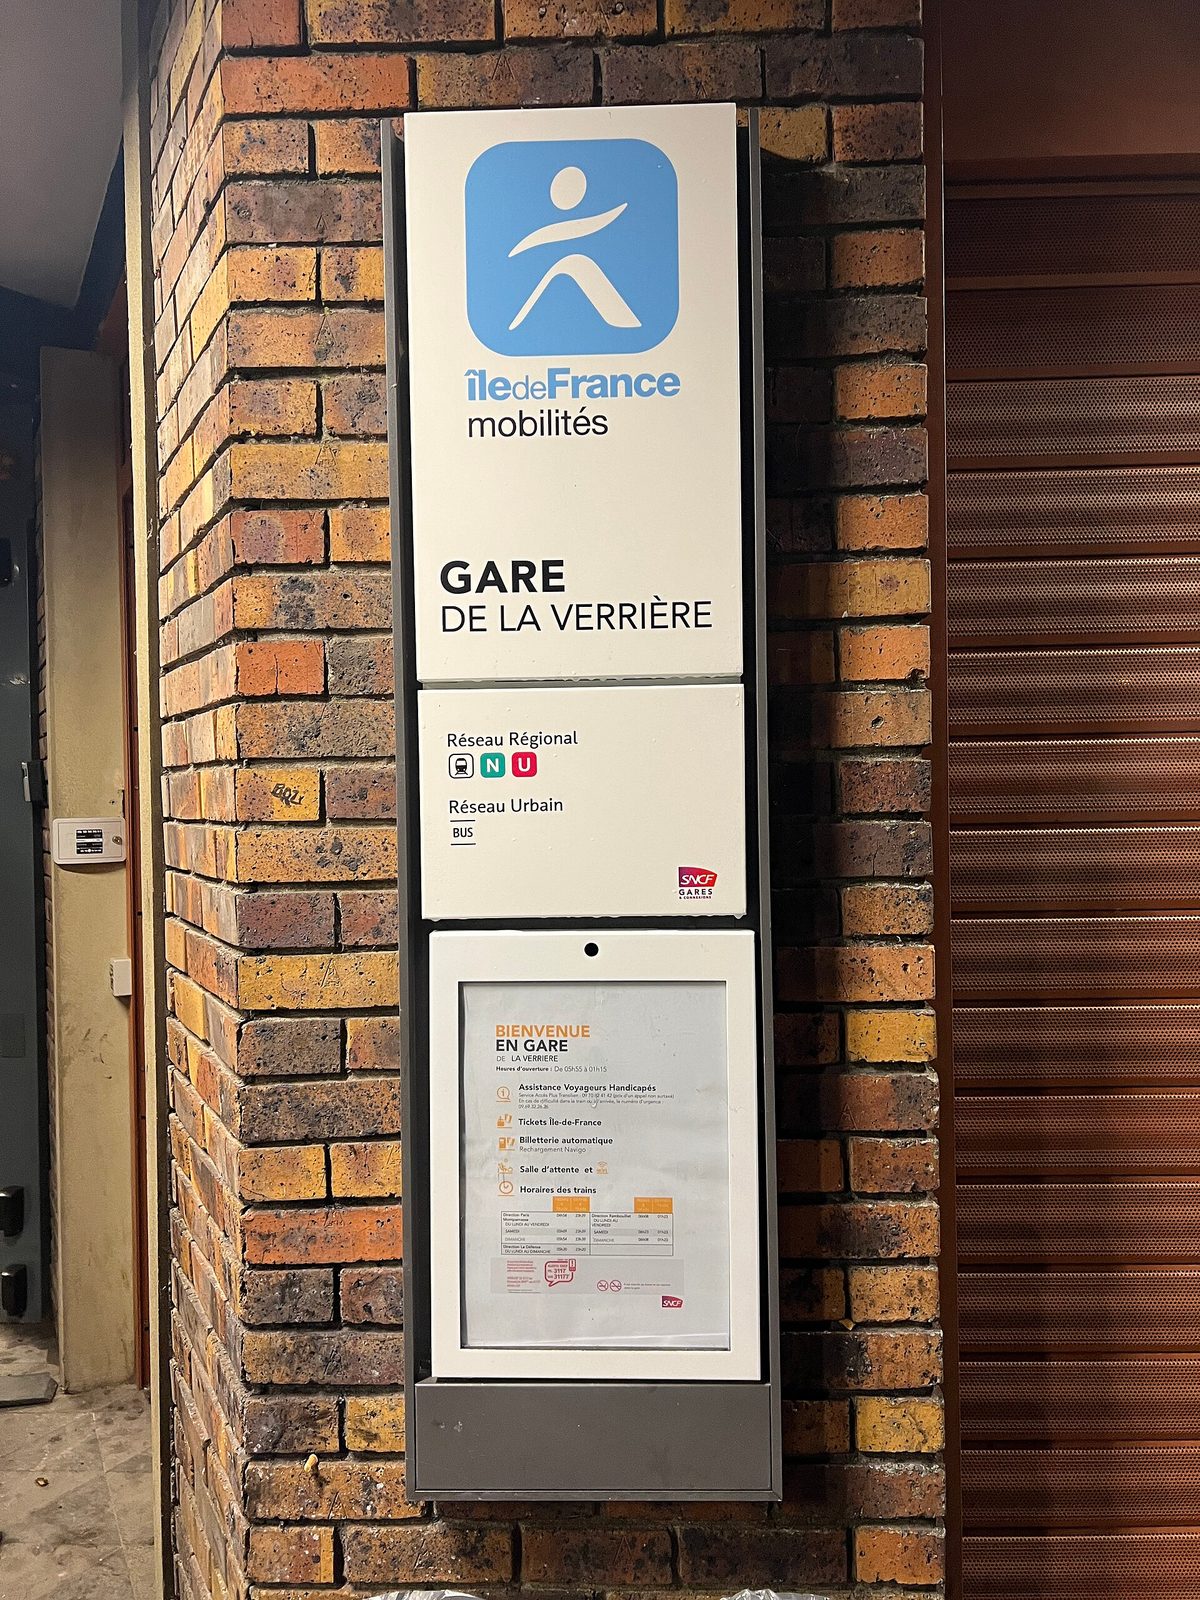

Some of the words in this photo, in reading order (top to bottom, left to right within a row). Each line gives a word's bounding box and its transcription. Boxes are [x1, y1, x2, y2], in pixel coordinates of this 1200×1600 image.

[464, 367, 680, 400] îledeFrance
[468, 406, 608, 438] mobilités
[440, 559, 566, 594] GARE
[442, 605, 488, 632] DE
[500, 604, 542, 632] LA
[551, 595, 712, 632] VERRIÈRE
[447, 733, 504, 748] Réseau
[509, 731, 578, 750] Régional
[486, 758, 500, 773] N
[518, 757, 531, 772] U
[449, 800, 505, 814] Réseau
[511, 798, 563, 812] Urbain
[453, 827, 474, 838] BUS
[681, 874, 715, 885] SNCF
[496, 1025, 590, 1038] BIENVENUE
[496, 1039, 518, 1052] EN
[524, 1039, 568, 1052] GARE
[564, 1084, 606, 1092] Voyageurs
[609, 1084, 656, 1093] Handicapés
[549, 1117, 602, 1126] Île-de-France
[519, 1136, 560, 1144] Billetterie
[561, 1137, 614, 1146] automatique
[520, 1146, 563, 1154] Rechargement
[520, 1166, 539, 1174] Salle
[541, 1166, 580, 1174] d'attente
[520, 1186, 554, 1194] Horaires
[557, 1186, 572, 1194] des
[574, 1186, 597, 1194] trains
